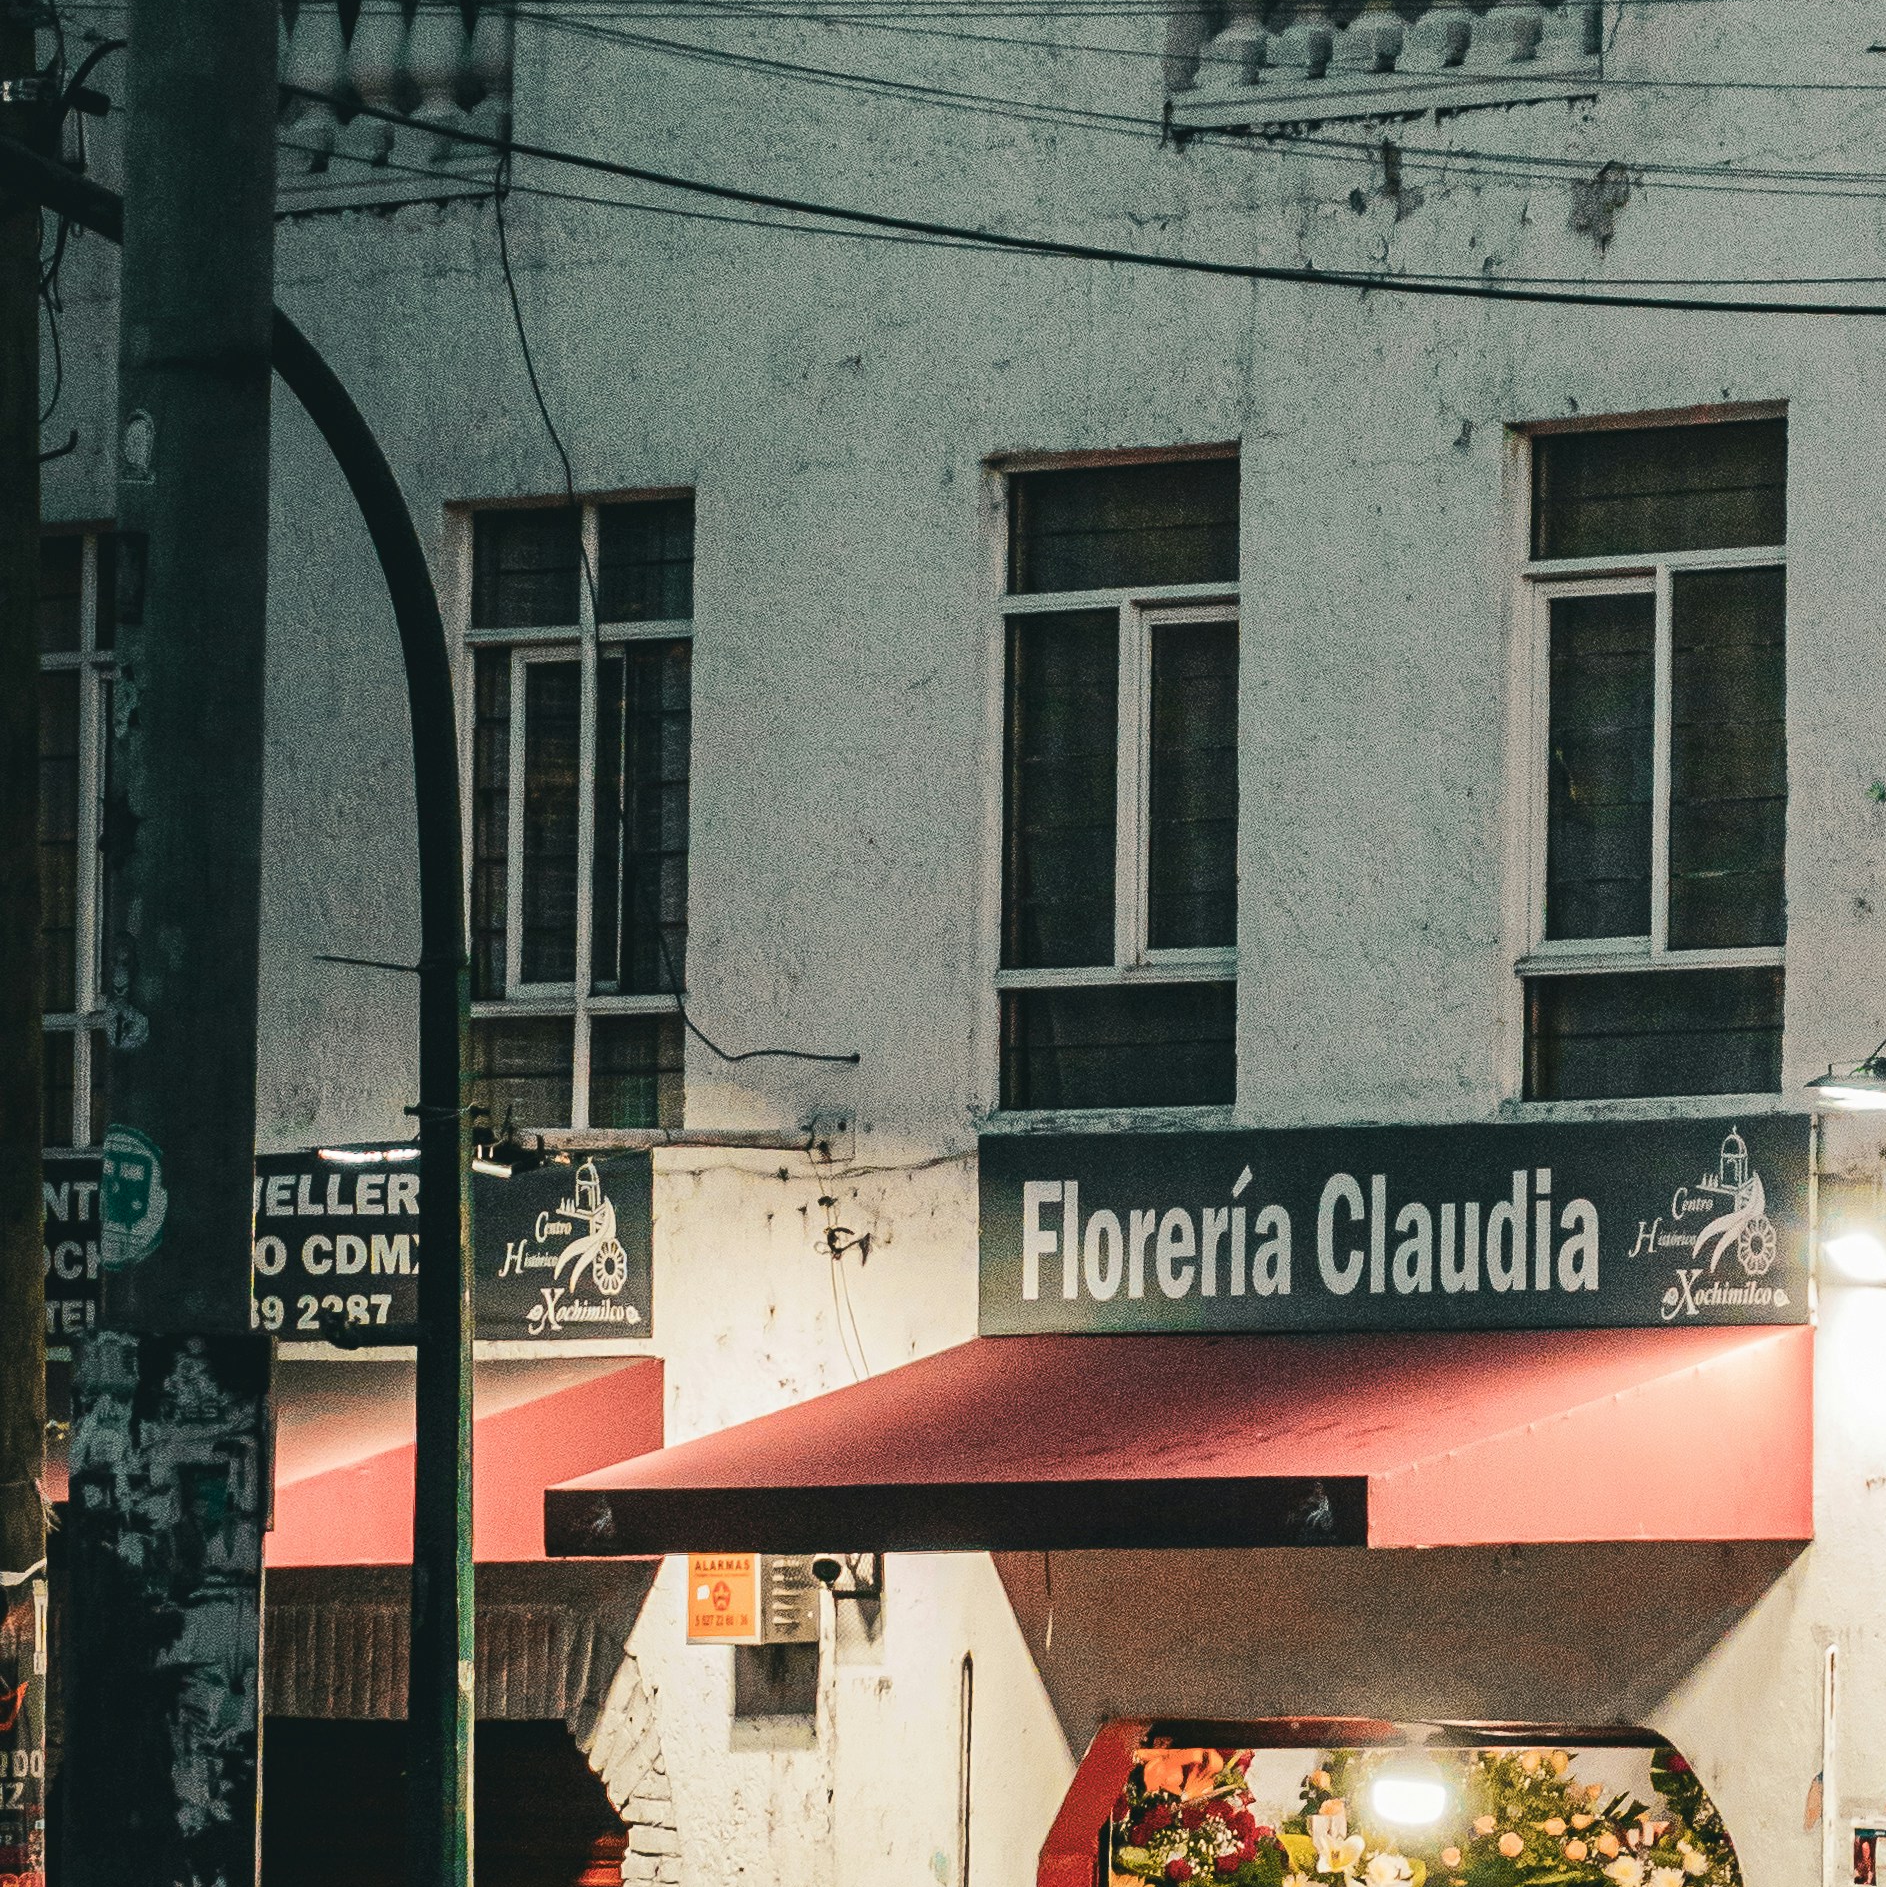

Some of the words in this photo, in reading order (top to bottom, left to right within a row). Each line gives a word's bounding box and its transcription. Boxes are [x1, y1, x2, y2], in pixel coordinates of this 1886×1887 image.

[1022, 1163, 1292, 1301] Florería
[1317, 1167, 1598, 1294] Claudia
[528, 1288, 625, 1335] Xochimilco
[1661, 1268, 1773, 1320] Xochimilco
